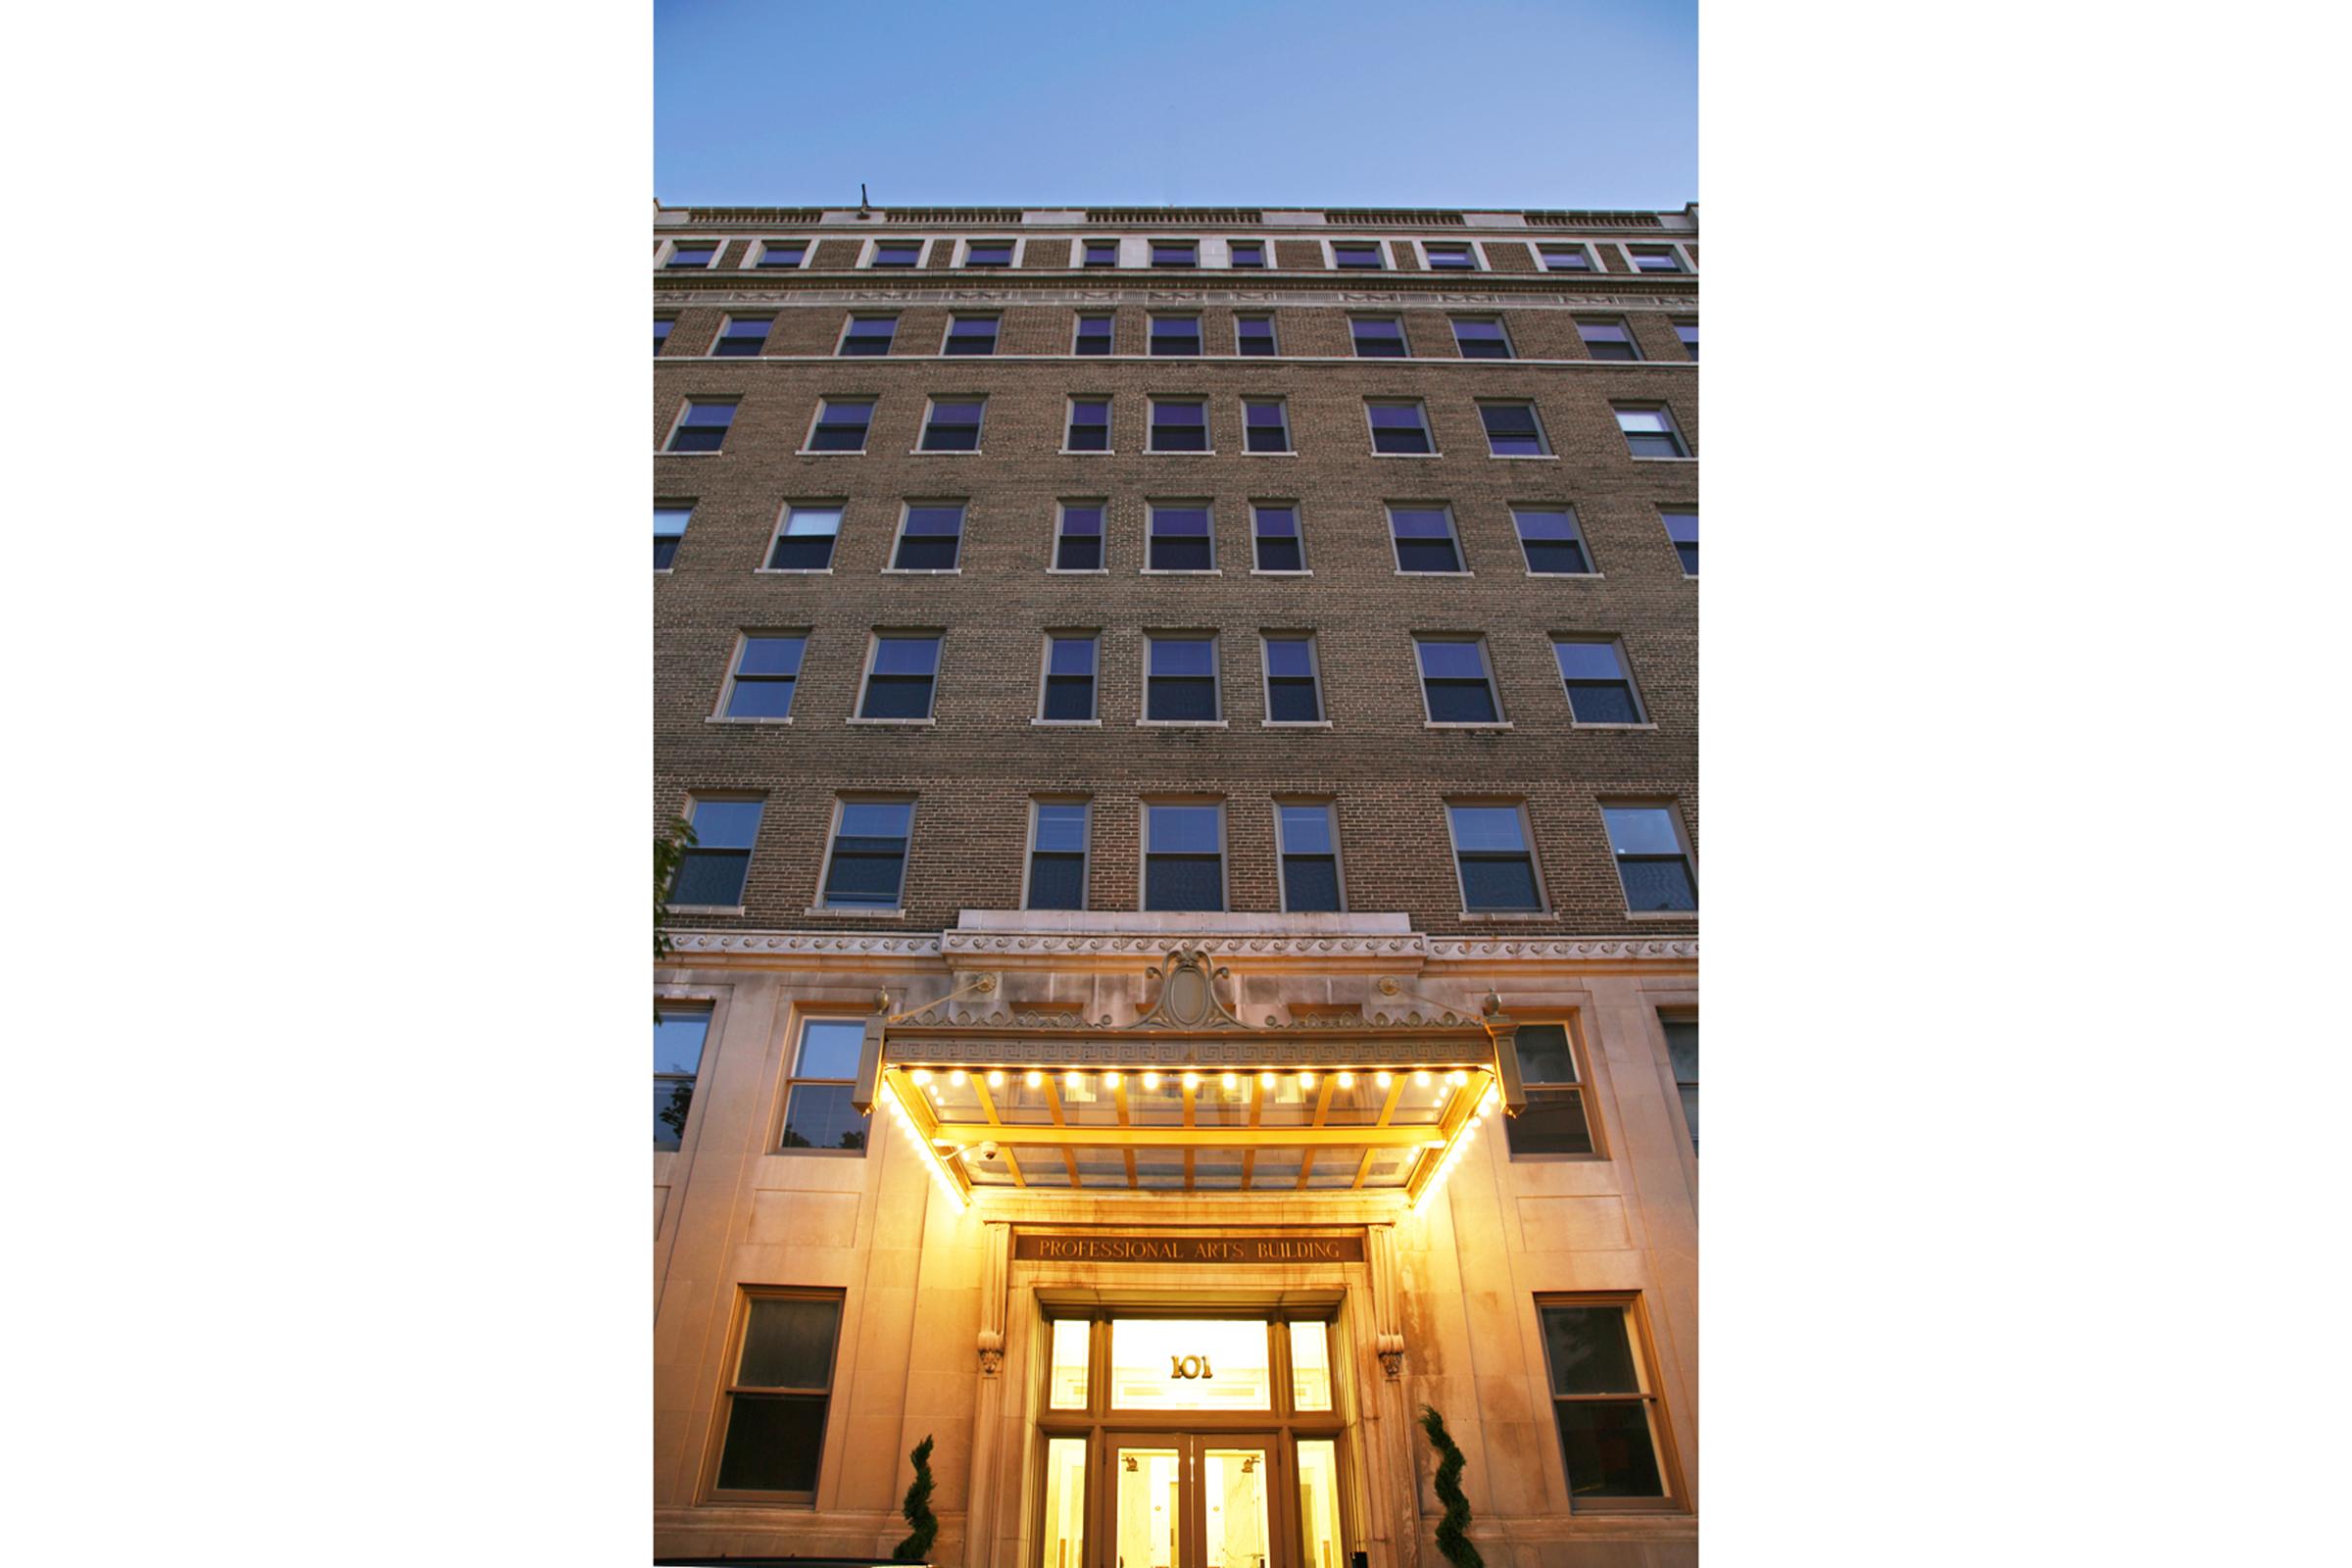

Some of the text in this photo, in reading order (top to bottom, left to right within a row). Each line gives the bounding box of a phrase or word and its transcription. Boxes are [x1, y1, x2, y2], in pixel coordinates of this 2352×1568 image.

[1039, 1240, 1341, 1258] PROFESSIONAL ARTS BUILDING
[1170, 1354, 1213, 1379] 101
